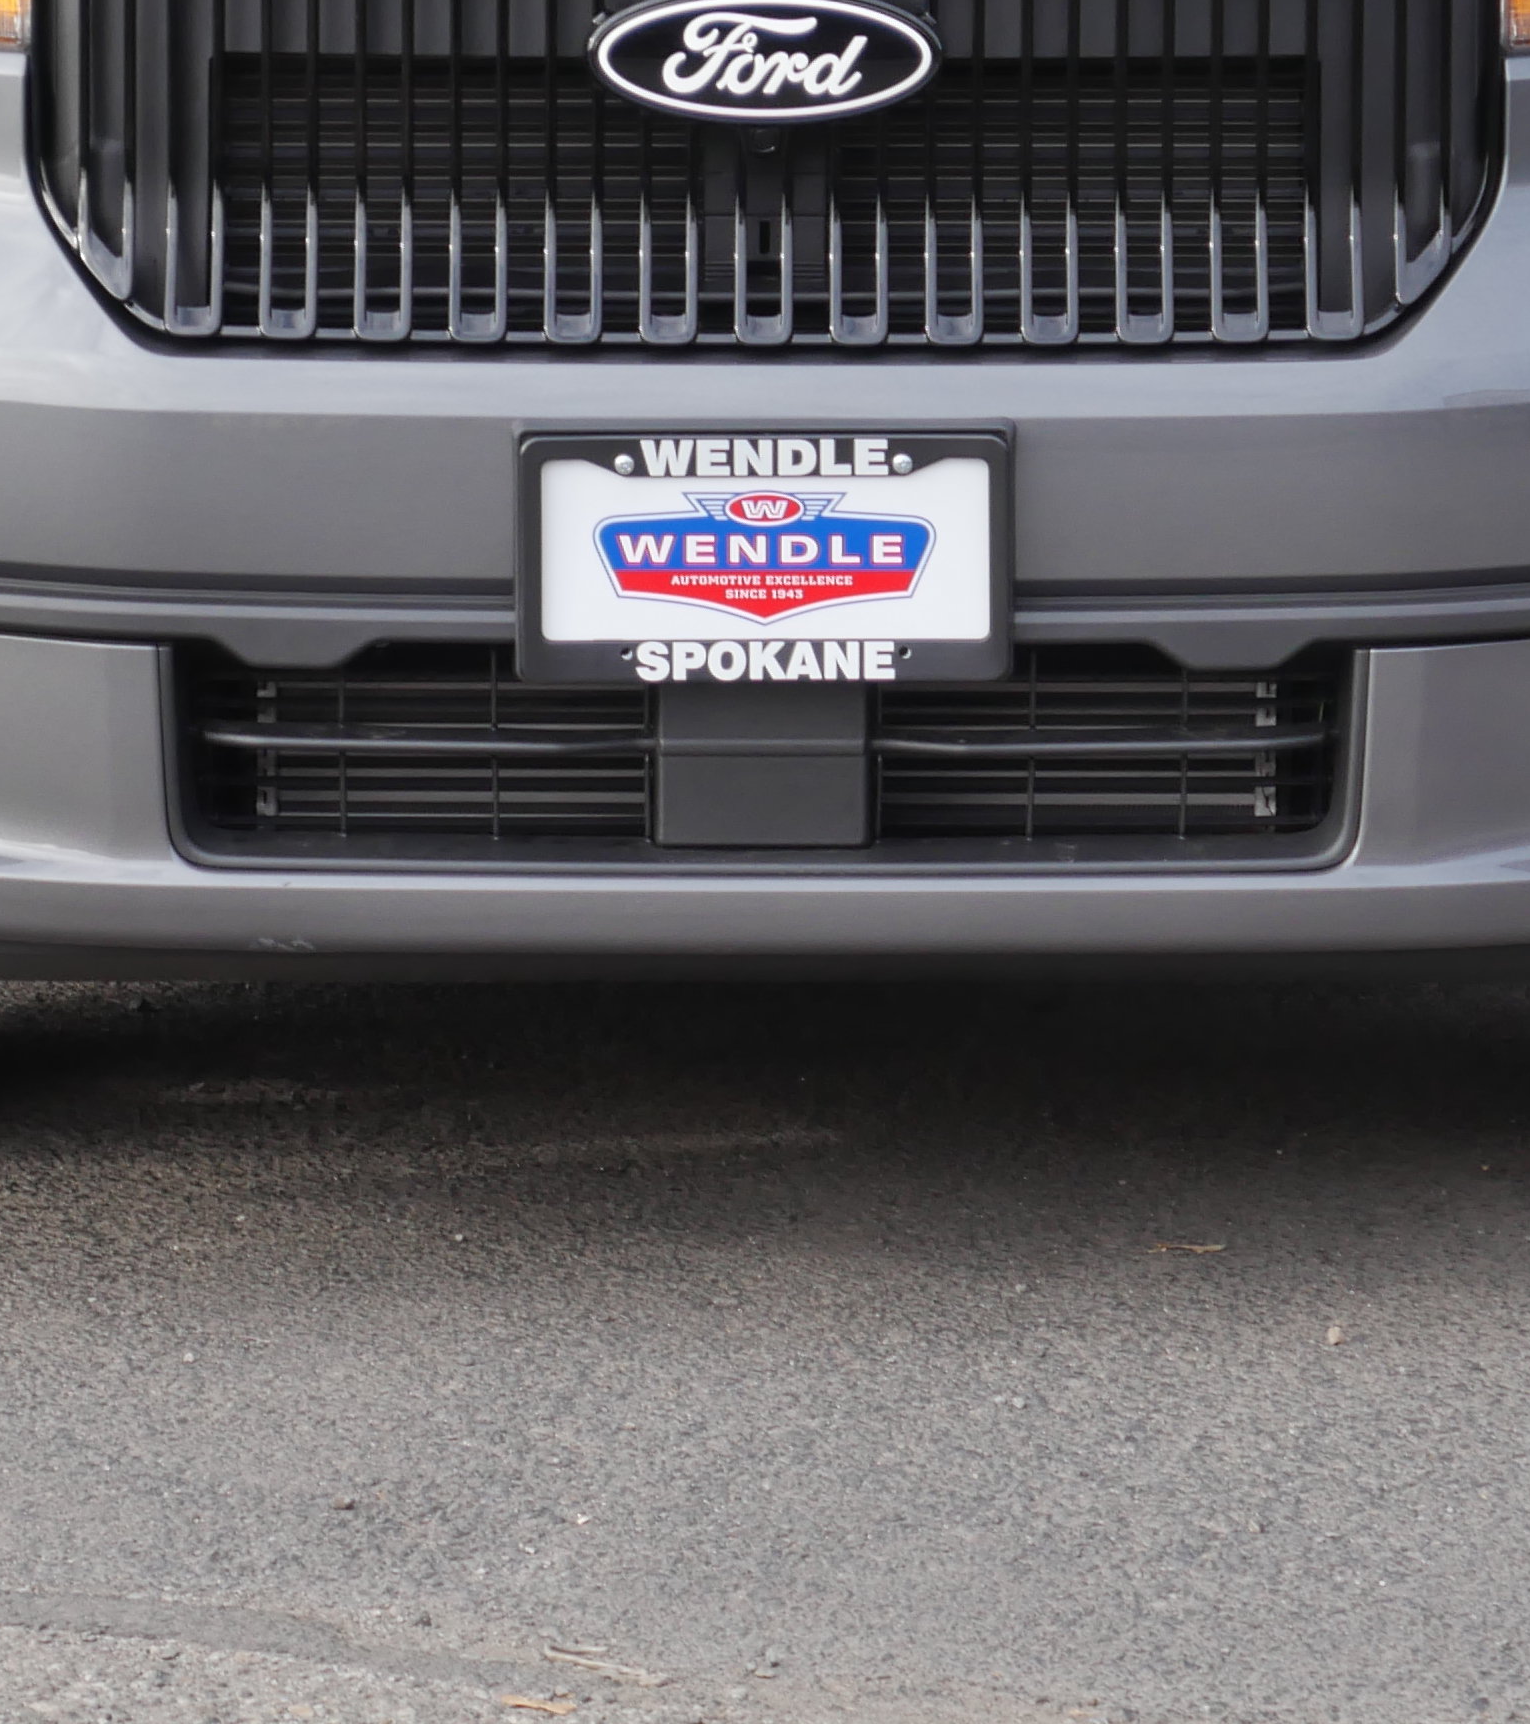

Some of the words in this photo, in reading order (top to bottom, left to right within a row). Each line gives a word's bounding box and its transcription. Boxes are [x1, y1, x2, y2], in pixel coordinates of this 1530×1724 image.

[661, 11, 868, 96] Ford
[639, 438, 890, 477] WENDLE
[741, 499, 788, 520] W
[617, 534, 905, 565] WENDLE
[671, 574, 761, 586] AUTOMOTIVE
[765, 574, 853, 586] EXCELLENCE
[724, 589, 767, 600] SINCE
[771, 589, 805, 600] 1943
[635, 640, 897, 682] SPOKANE
